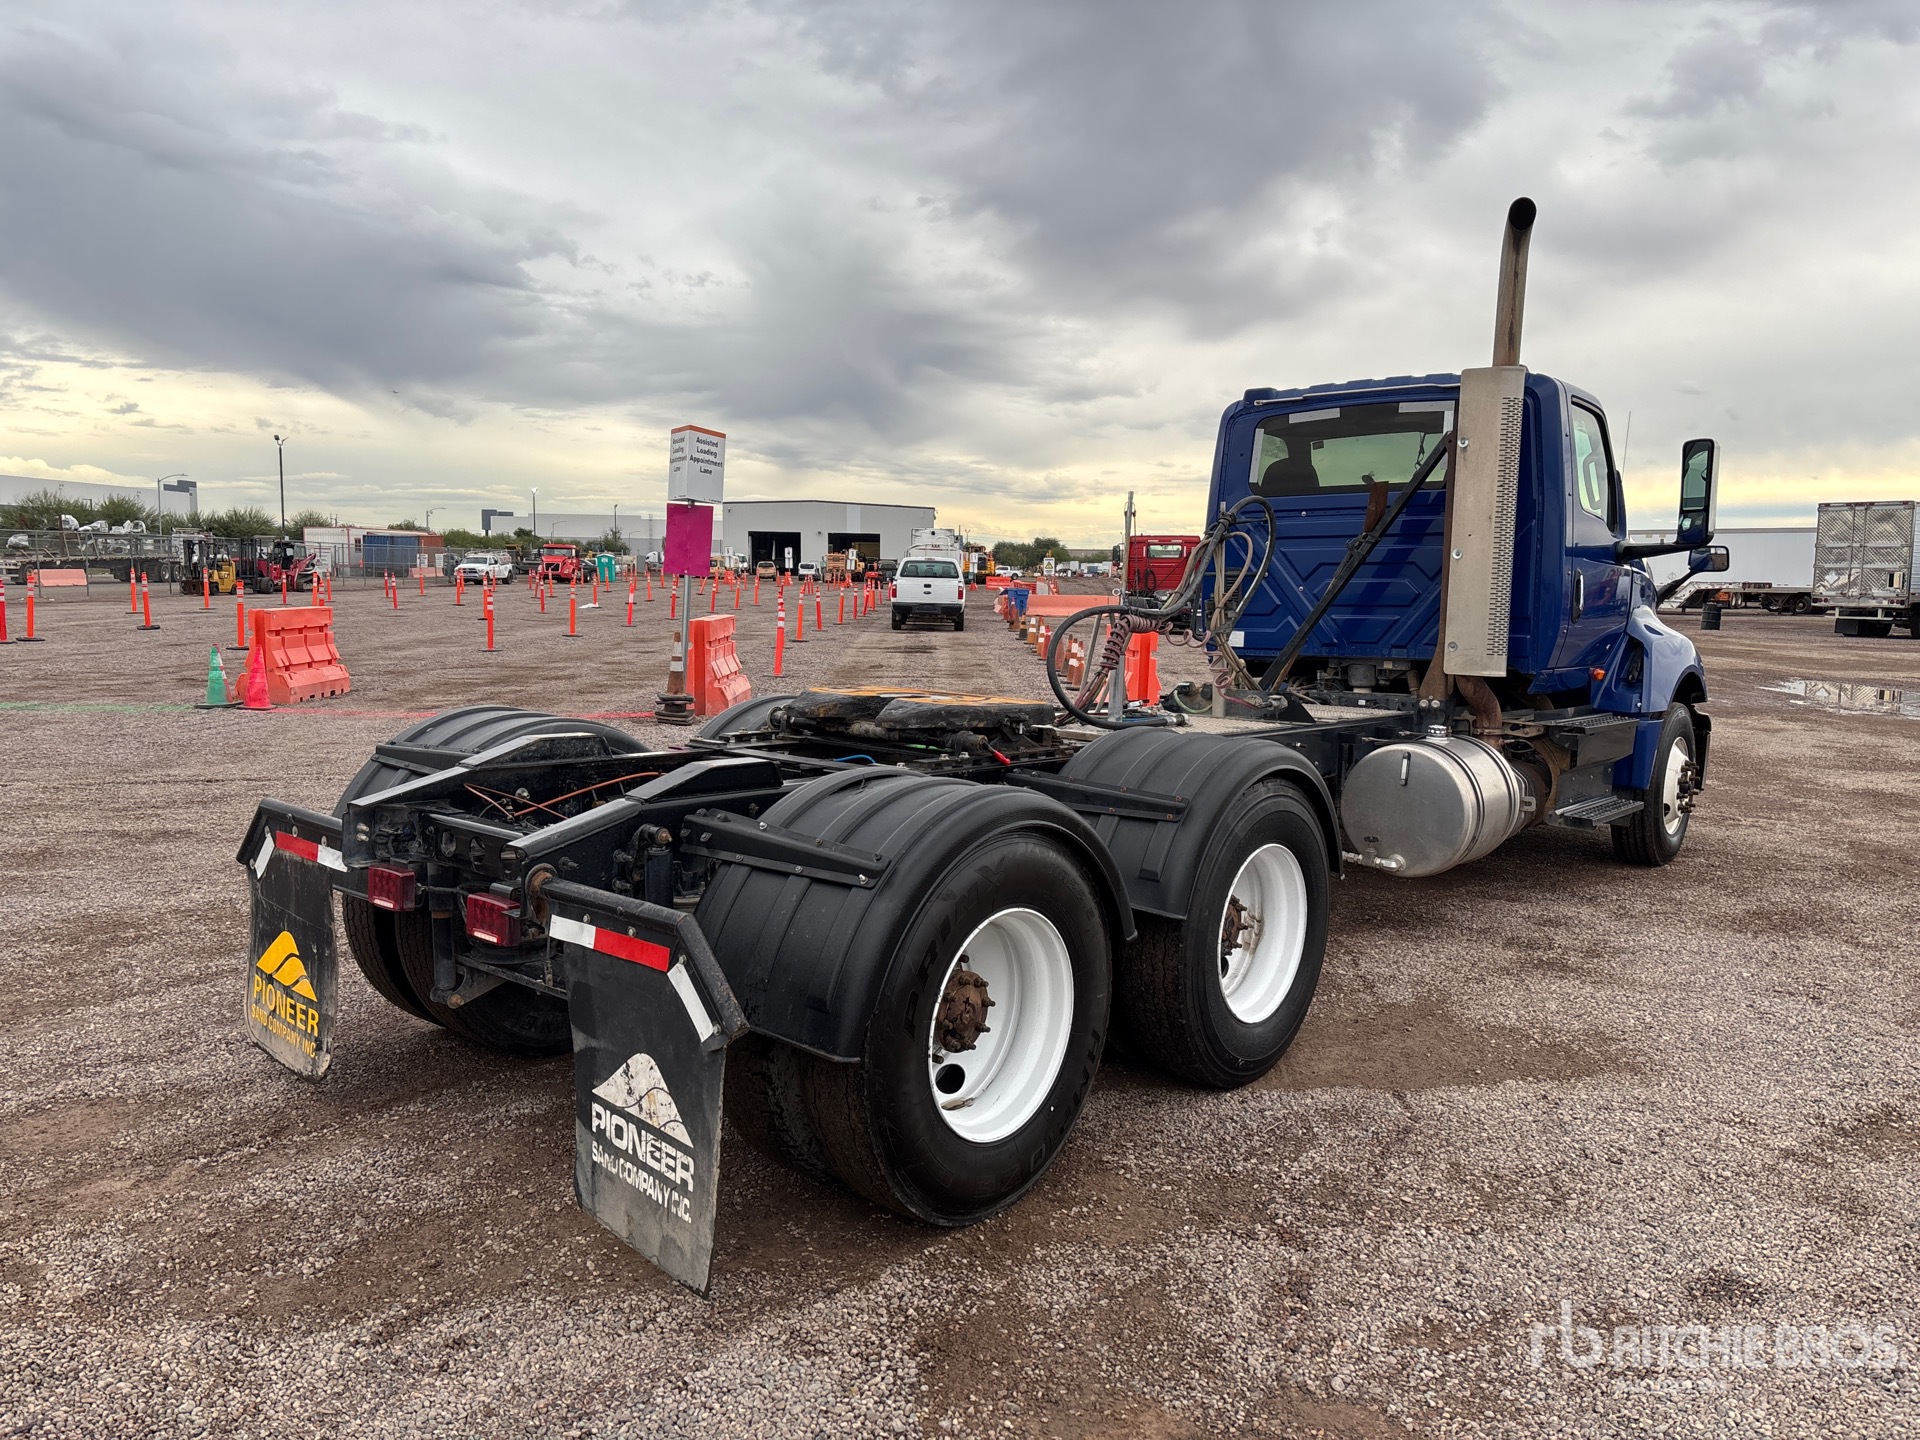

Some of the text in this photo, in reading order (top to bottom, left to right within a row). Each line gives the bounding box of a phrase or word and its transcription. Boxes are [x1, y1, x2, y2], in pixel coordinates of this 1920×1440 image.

[696, 437, 718, 447] Assisted
[697, 446, 717, 458] Loading
[690, 455, 722, 468] Appointment
[700, 466, 712, 475] Lane
[253, 974, 320, 1038] PIONEER
[251, 1003, 318, 1060] SAND COMPANY INC.
[591, 1101, 695, 1193] PIONEER
[618, 1157, 671, 1209] COMPANY
[671, 1188, 692, 1224] INC.
